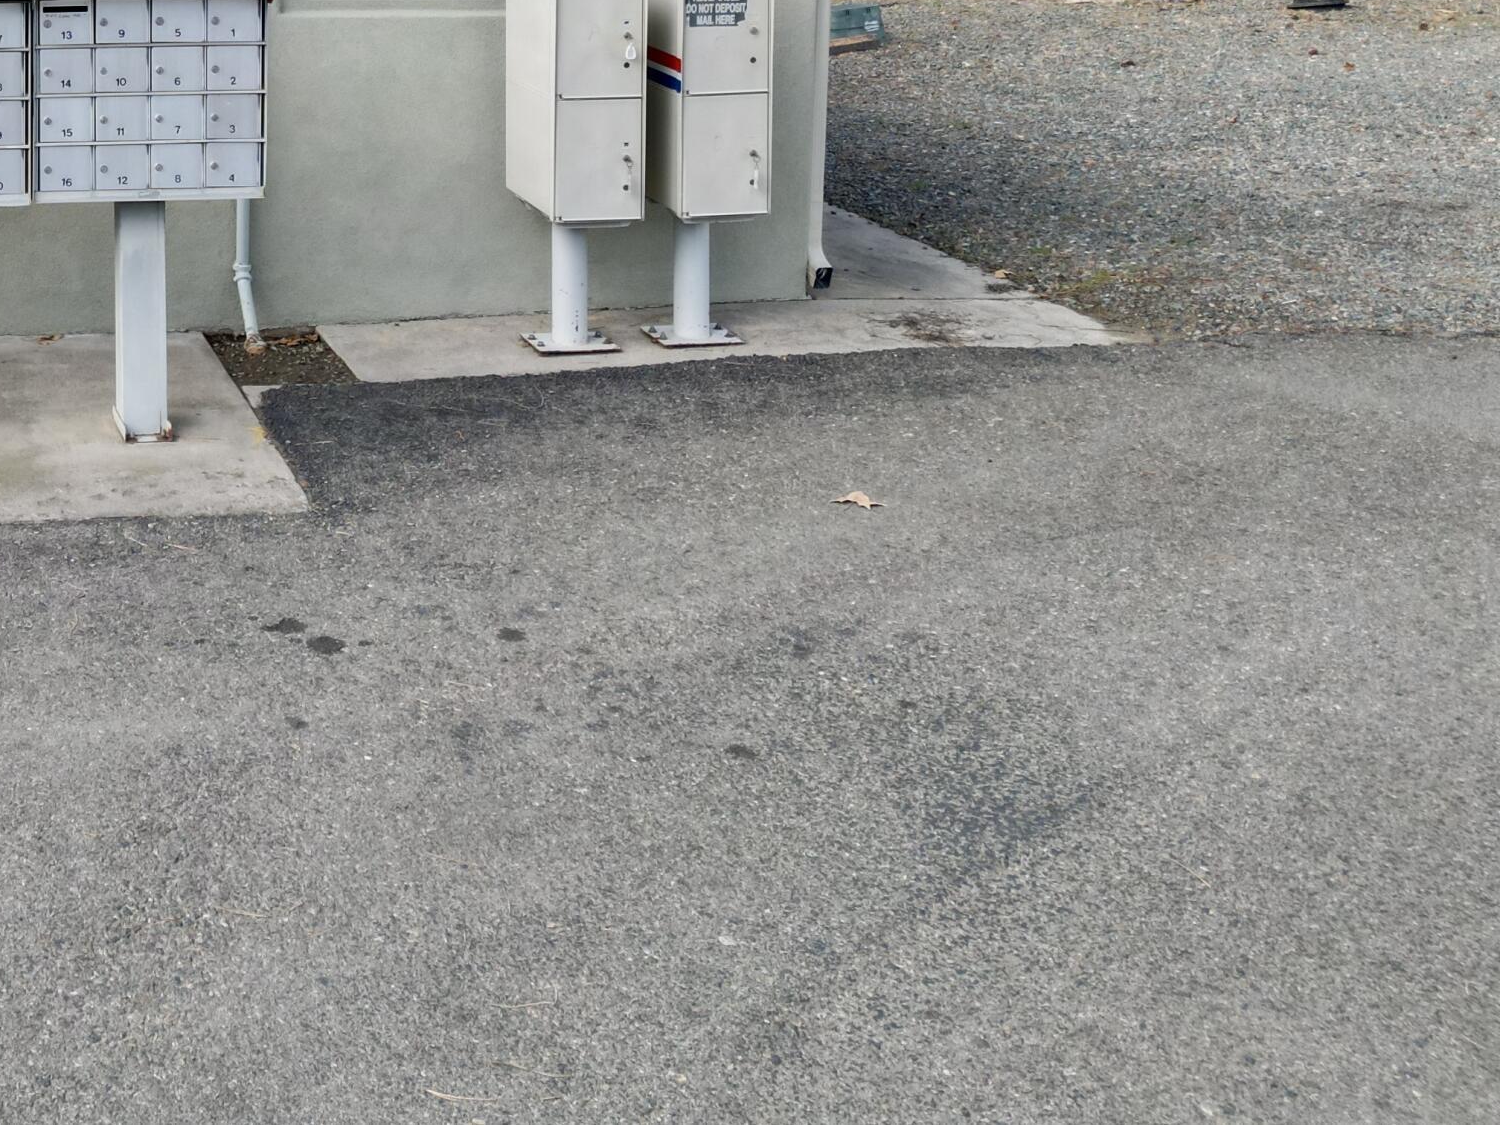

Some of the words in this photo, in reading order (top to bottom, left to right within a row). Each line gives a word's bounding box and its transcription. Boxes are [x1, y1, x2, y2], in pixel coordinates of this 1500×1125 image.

[686, 3, 697, 14] DO
[698, 3, 714, 14] NOT
[715, 2, 746, 13] DEPOSIT
[696, 15, 714, 25] MAIL
[715, 14, 736, 25] HERE
[60, 30, 73, 40] 13
[118, 29, 126, 39] 9
[174, 28, 182, 38] 5
[230, 28, 236, 37] 1
[60, 79, 72, 89] 14
[115, 77, 127, 87] 10
[174, 76, 181, 86] 6
[230, 76, 237, 86] 2
[61, 128, 73, 138] 15
[116, 127, 125, 136] 11
[174, 125, 181, 135] 7
[229, 124, 236, 134] 3
[61, 177, 73, 187] 16
[117, 175, 129, 185] 12
[174, 174, 182, 184] 8
[228, 173, 235, 183] 4
